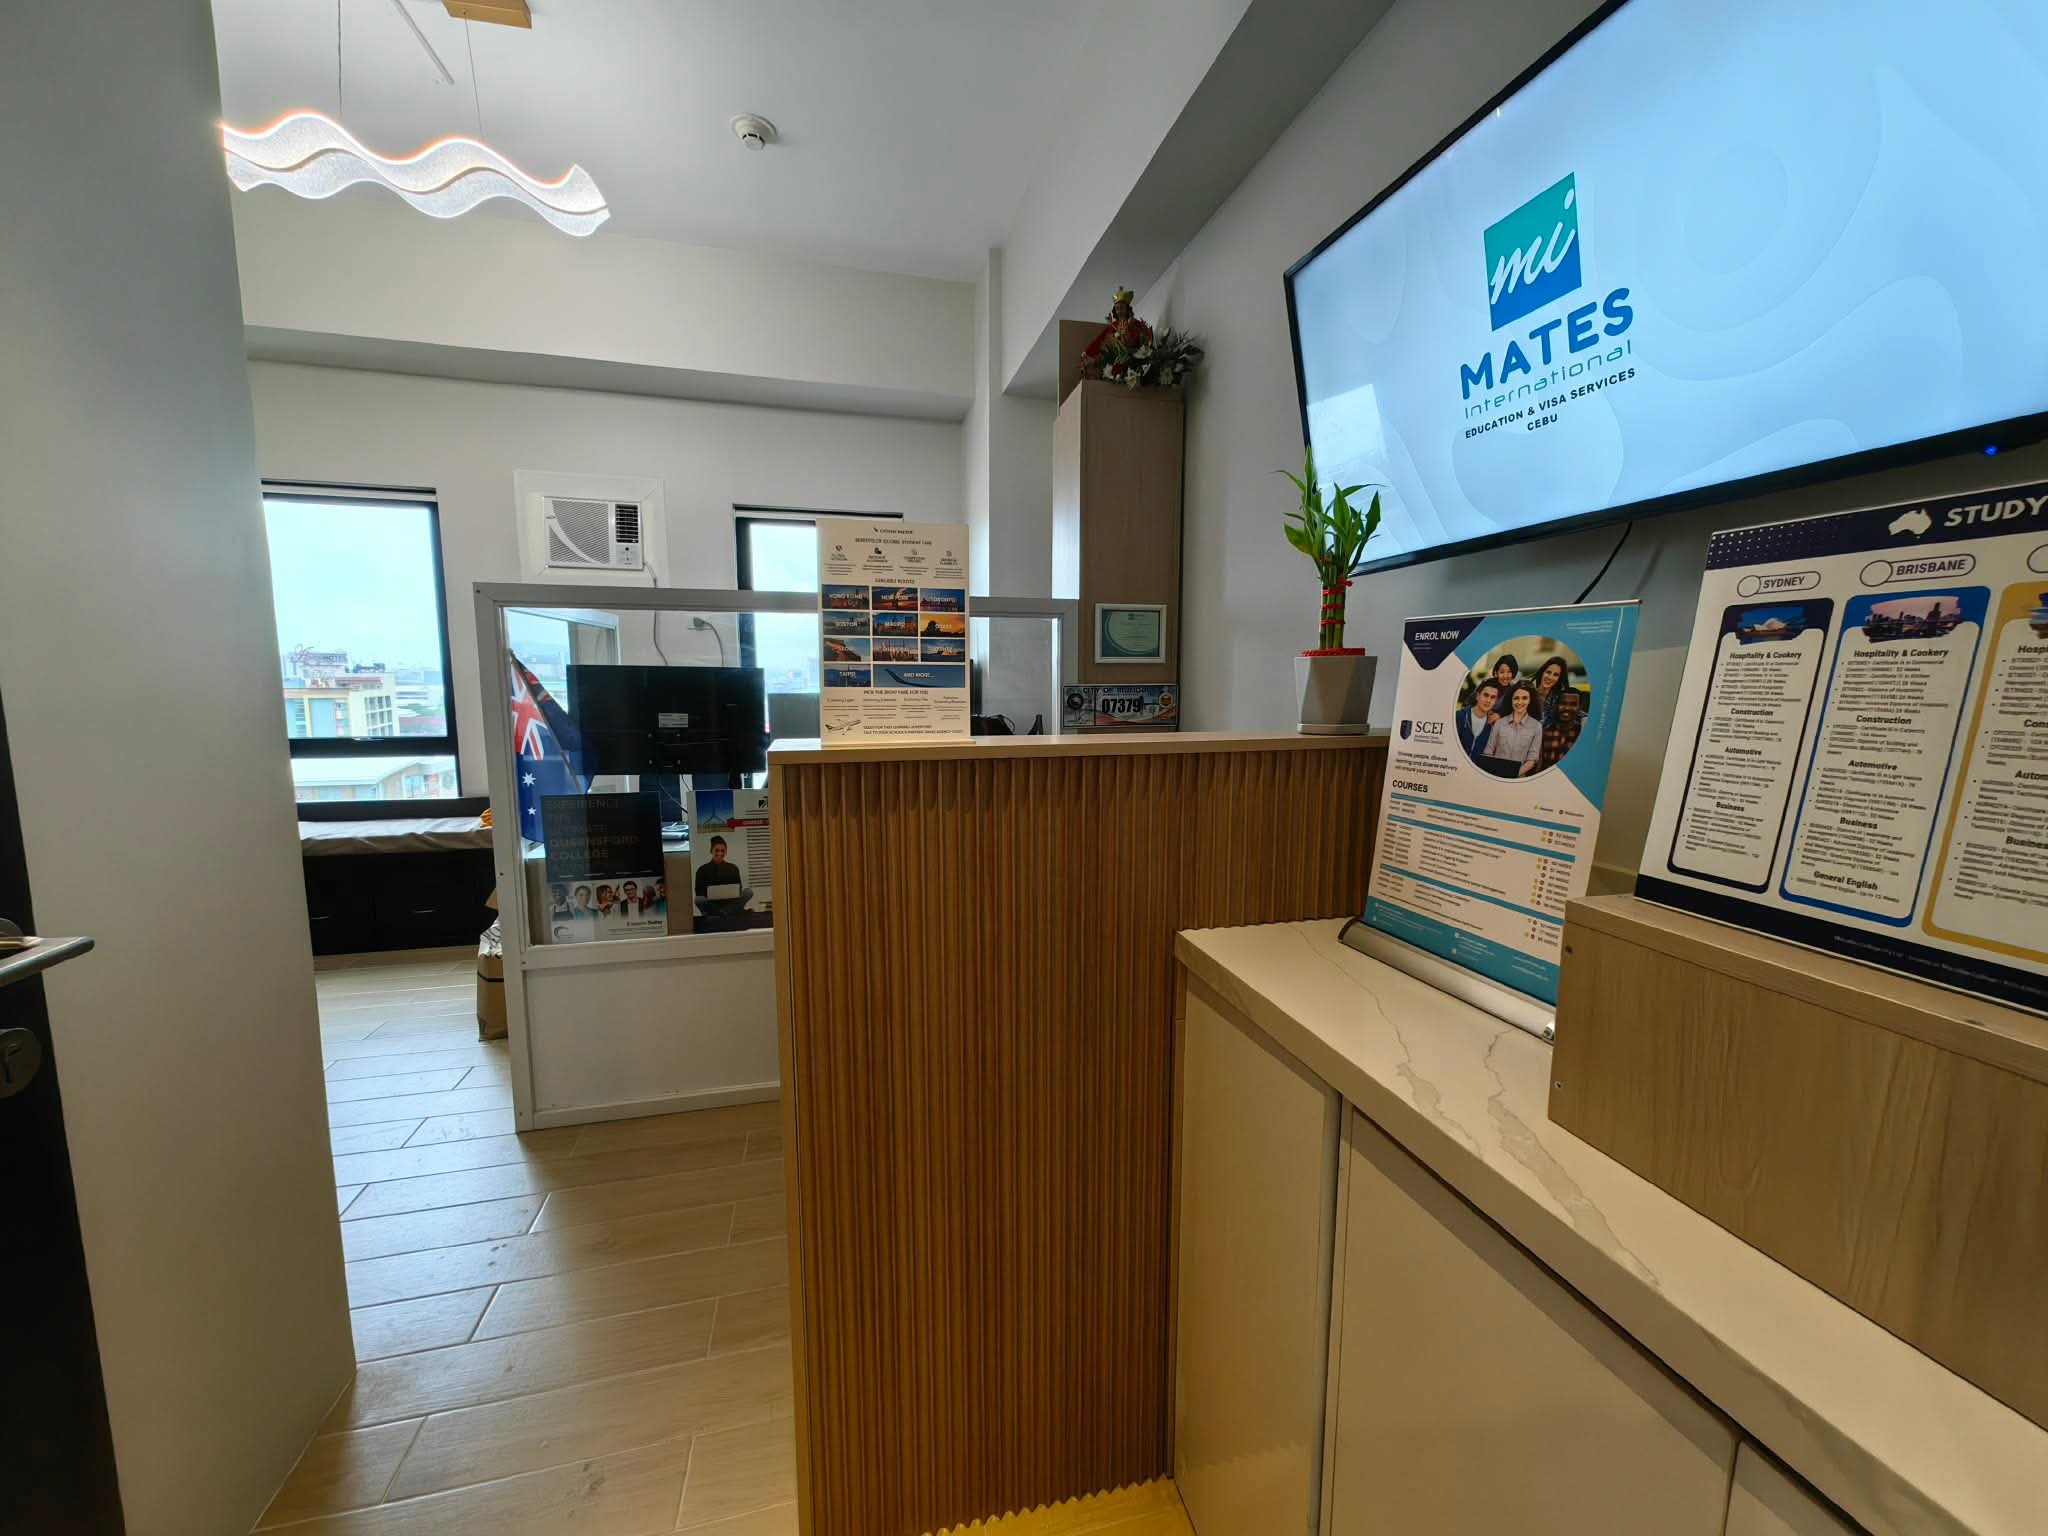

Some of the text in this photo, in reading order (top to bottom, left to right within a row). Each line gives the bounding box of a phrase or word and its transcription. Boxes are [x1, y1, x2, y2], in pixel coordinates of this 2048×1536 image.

[1460, 287, 1633, 400] MATES
[1465, 340, 1631, 419] International
[1465, 367, 1636, 439] EDUCATION & VISA SERVICES
[1527, 413, 1558, 431] CEBU
[1944, 496, 2048, 528] STUDY
[1896, 559, 1967, 576] BRISBANE
[1763, 575, 1805, 589] SYDNEY
[1415, 630, 1459, 641] ENROL NOW
[1730, 652, 1765, 660] Hospitality
[1773, 651, 1802, 660] Cookery
[1854, 650, 1899, 659] Hospitality
[1910, 649, 1949, 657] Cookery
[1102, 698, 1141, 713] 07379
[1731, 708, 1773, 716] Construction
[1856, 715, 1912, 725] Construction
[1415, 721, 1443, 735] SCEI
[1725, 746, 1762, 756] Automotive
[1848, 760, 1897, 771] Automotive
[1392, 779, 1428, 793] COURSES
[1716, 802, 1744, 811] Business
[1840, 817, 1878, 829] Business
[1814, 871, 1878, 891] General English
